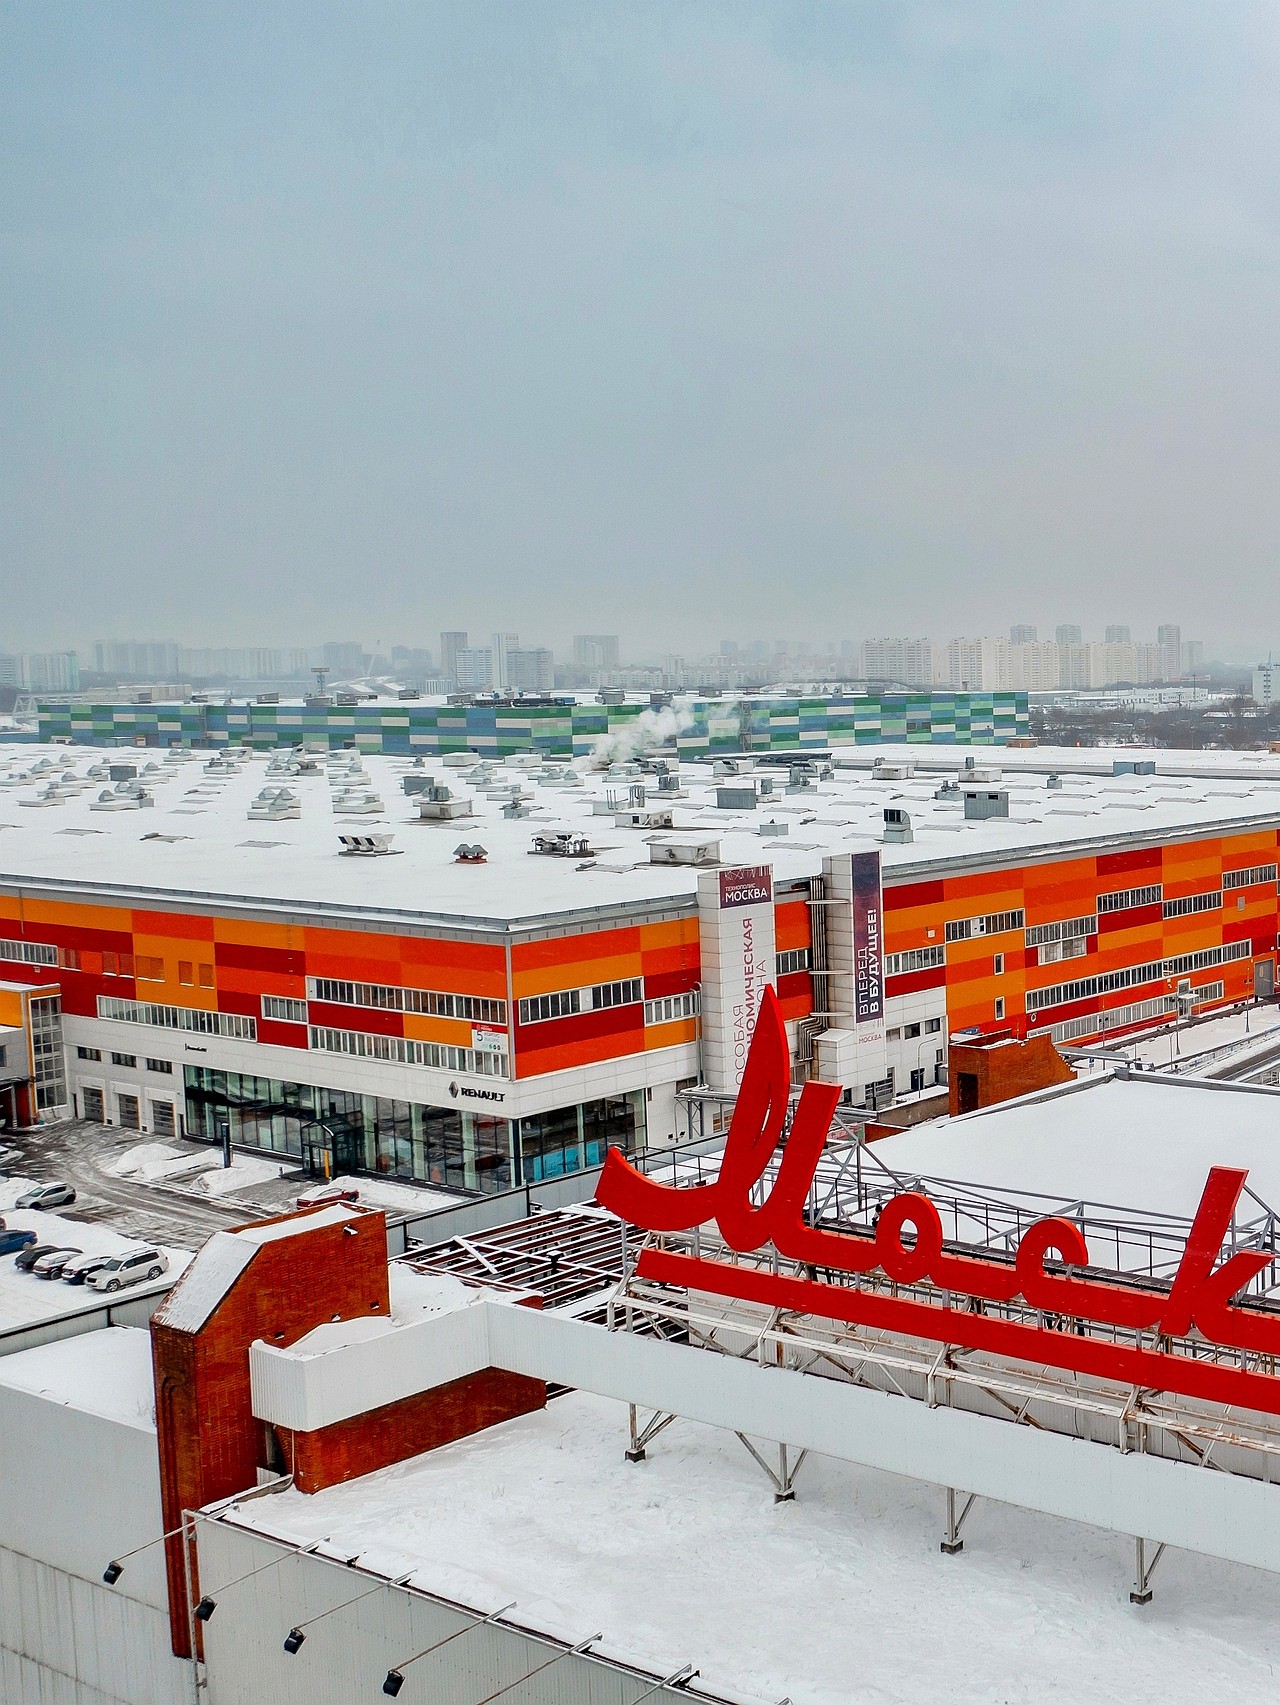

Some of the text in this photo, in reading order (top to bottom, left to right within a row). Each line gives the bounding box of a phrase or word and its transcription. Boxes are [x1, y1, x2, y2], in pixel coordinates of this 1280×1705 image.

[725, 883, 756, 892] ТЕХНОПОЛИС
[725, 887, 768, 903] МОСКВА
[867, 908, 880, 1014] В БУДУЩЕЕ!
[743, 918, 754, 1052] НОМИЧЕСКАЯ
[756, 959, 767, 1013] ОНА
[858, 946, 869, 1015] ВПЕРЕД
[476, 1030, 484, 1041] 5
[733, 1004, 746, 1086] ОСОБАЯ
[859, 1034, 882, 1044] МОСКВА
[461, 1087, 505, 1102] RENAULT
